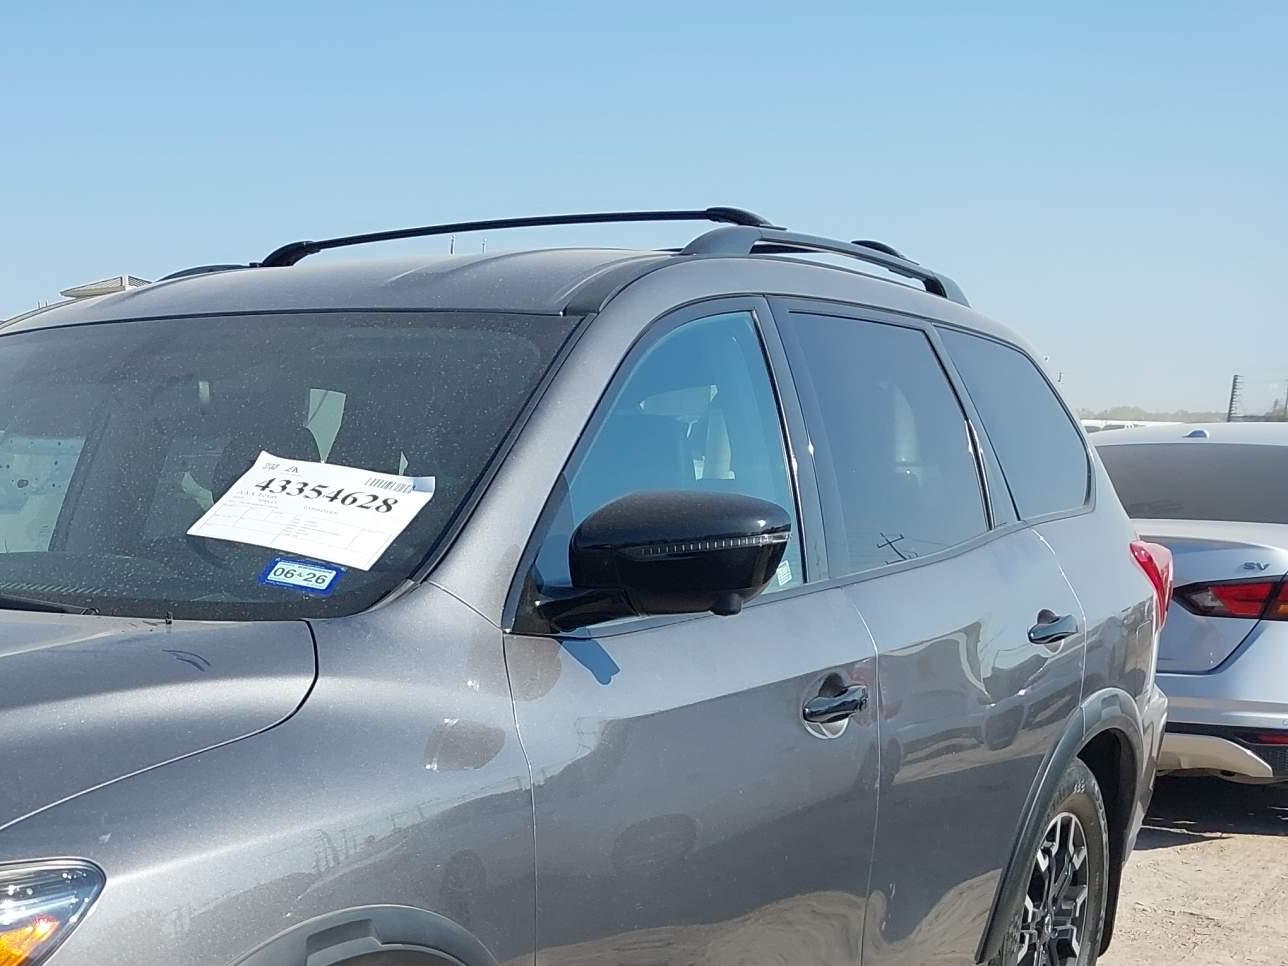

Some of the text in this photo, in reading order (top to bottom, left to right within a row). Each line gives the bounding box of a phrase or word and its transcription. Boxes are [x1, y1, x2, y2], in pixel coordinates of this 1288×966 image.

[255, 477, 399, 514] 43354628
[1242, 561, 1271, 571] SV
[273, 567, 328, 585] 06 26
